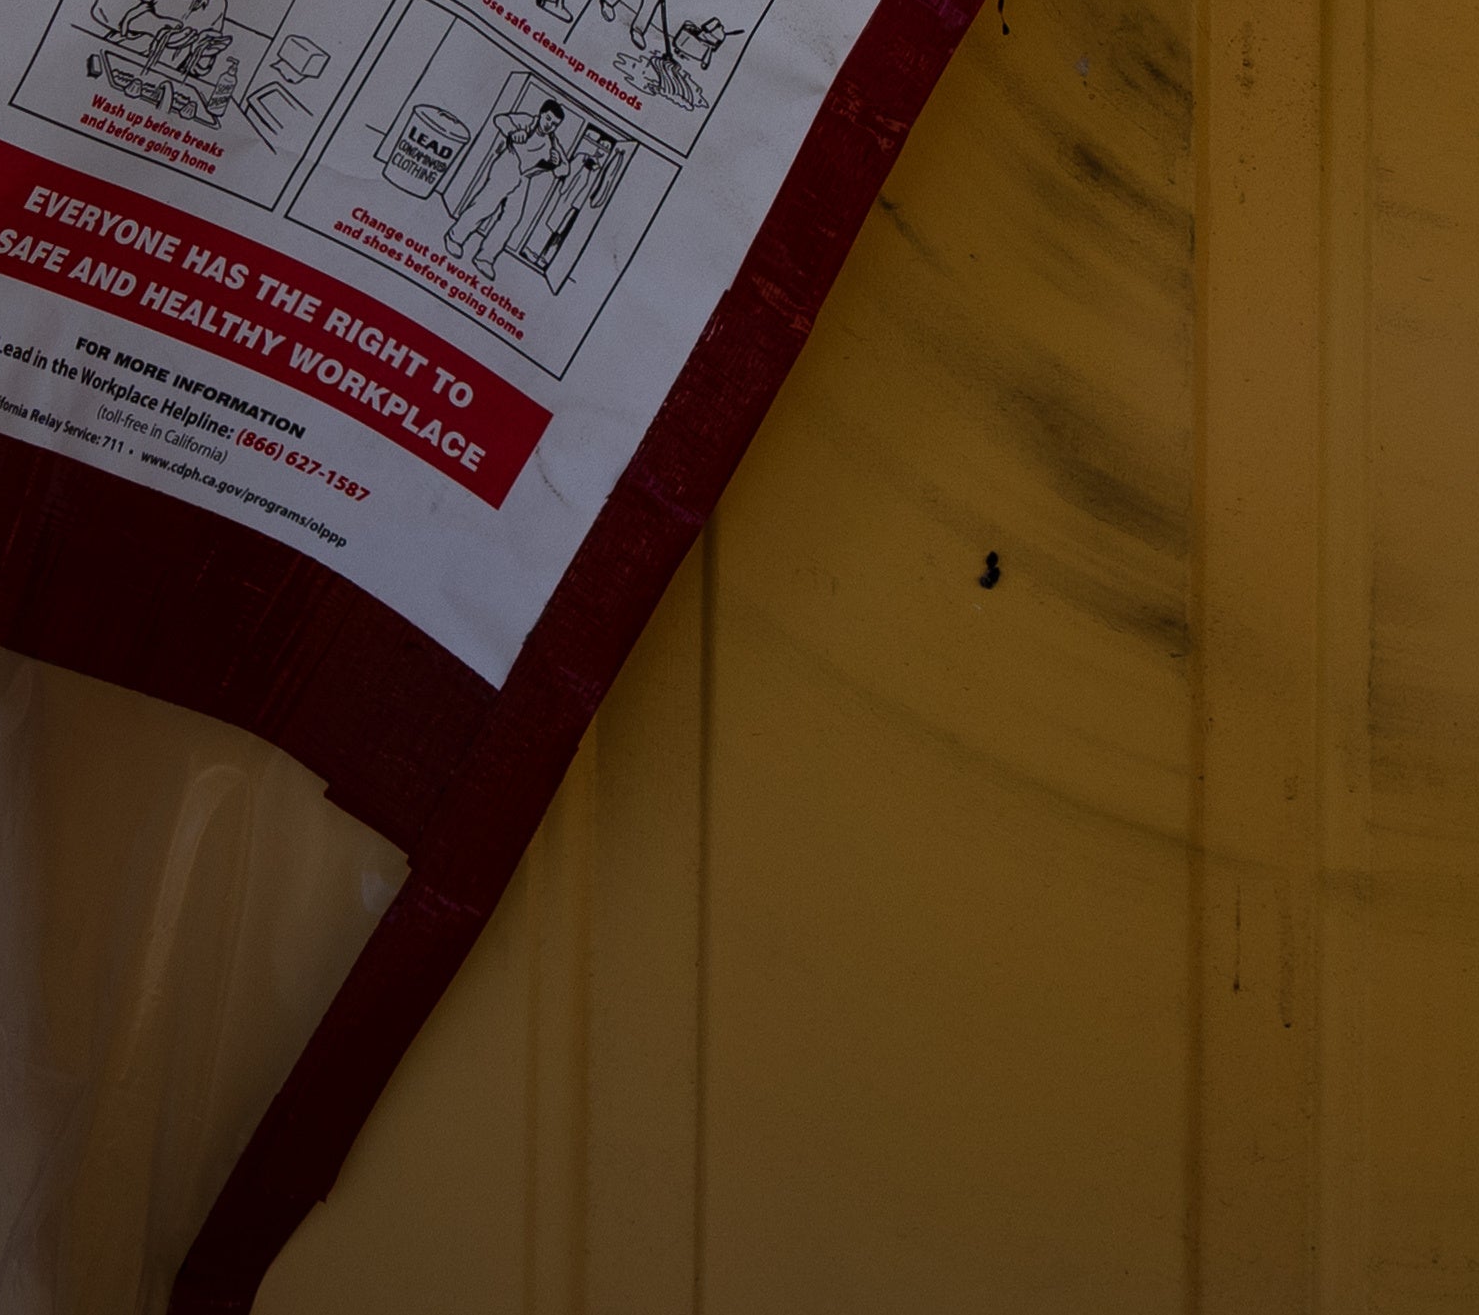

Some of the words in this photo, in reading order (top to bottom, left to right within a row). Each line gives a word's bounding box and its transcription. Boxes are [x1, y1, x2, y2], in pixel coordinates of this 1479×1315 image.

[503, 11, 531, 35] safe
[531, 30, 585, 72] clean-up
[585, 68, 642, 111] methods
[79, 113, 108, 131] and
[104, 119, 146, 146] before
[143, 139, 180, 162] going
[179, 149, 216, 174] home
[91, 93, 125, 118] Wash
[125, 111, 143, 127] up
[142, 115, 182, 140] before
[181, 130, 224, 157] breaks
[390, 151, 438, 186] CLOTHING
[406, 126, 454, 161] LEAD
[22, 184, 182, 263] EVERYONE
[180, 243, 250, 290] HAS
[254, 272, 323, 323] THE
[321, 306, 430, 378] RIGHT
[431, 365, 474, 409] TO
[333, 220, 364, 240] and
[361, 234, 403, 262] shoes
[403, 253, 448, 289] before
[447, 285, 487, 316] going
[487, 307, 524, 340] home
[350, 206, 404, 242] Change
[404, 237, 429, 257] out
[429, 252, 447, 266] of
[445, 261, 479, 289] work
[479, 285, 525, 320] clothes
[66, 255, 138, 298] AND
[138, 280, 287, 356] HEALTHY
[287, 340, 487, 473] WORKPLACE
[75, 336, 111, 361] FOR
[113, 351, 170, 383] MORE
[171, 374, 306, 439] INFORMATION
[28, 407, 63, 433] Relay
[61, 419, 101, 445] Service:
[101, 434, 124, 453] 711
[140, 451, 347, 548] www.cdph.ca.gov/programs/olppp
[31, 349, 48, 370] in
[50, 357, 78, 380] the
[80, 365, 159, 411] Workplace
[159, 397, 234, 439] Helpline:
[235, 428, 284, 461] (866)
[284, 450, 370, 501] 627-1587
